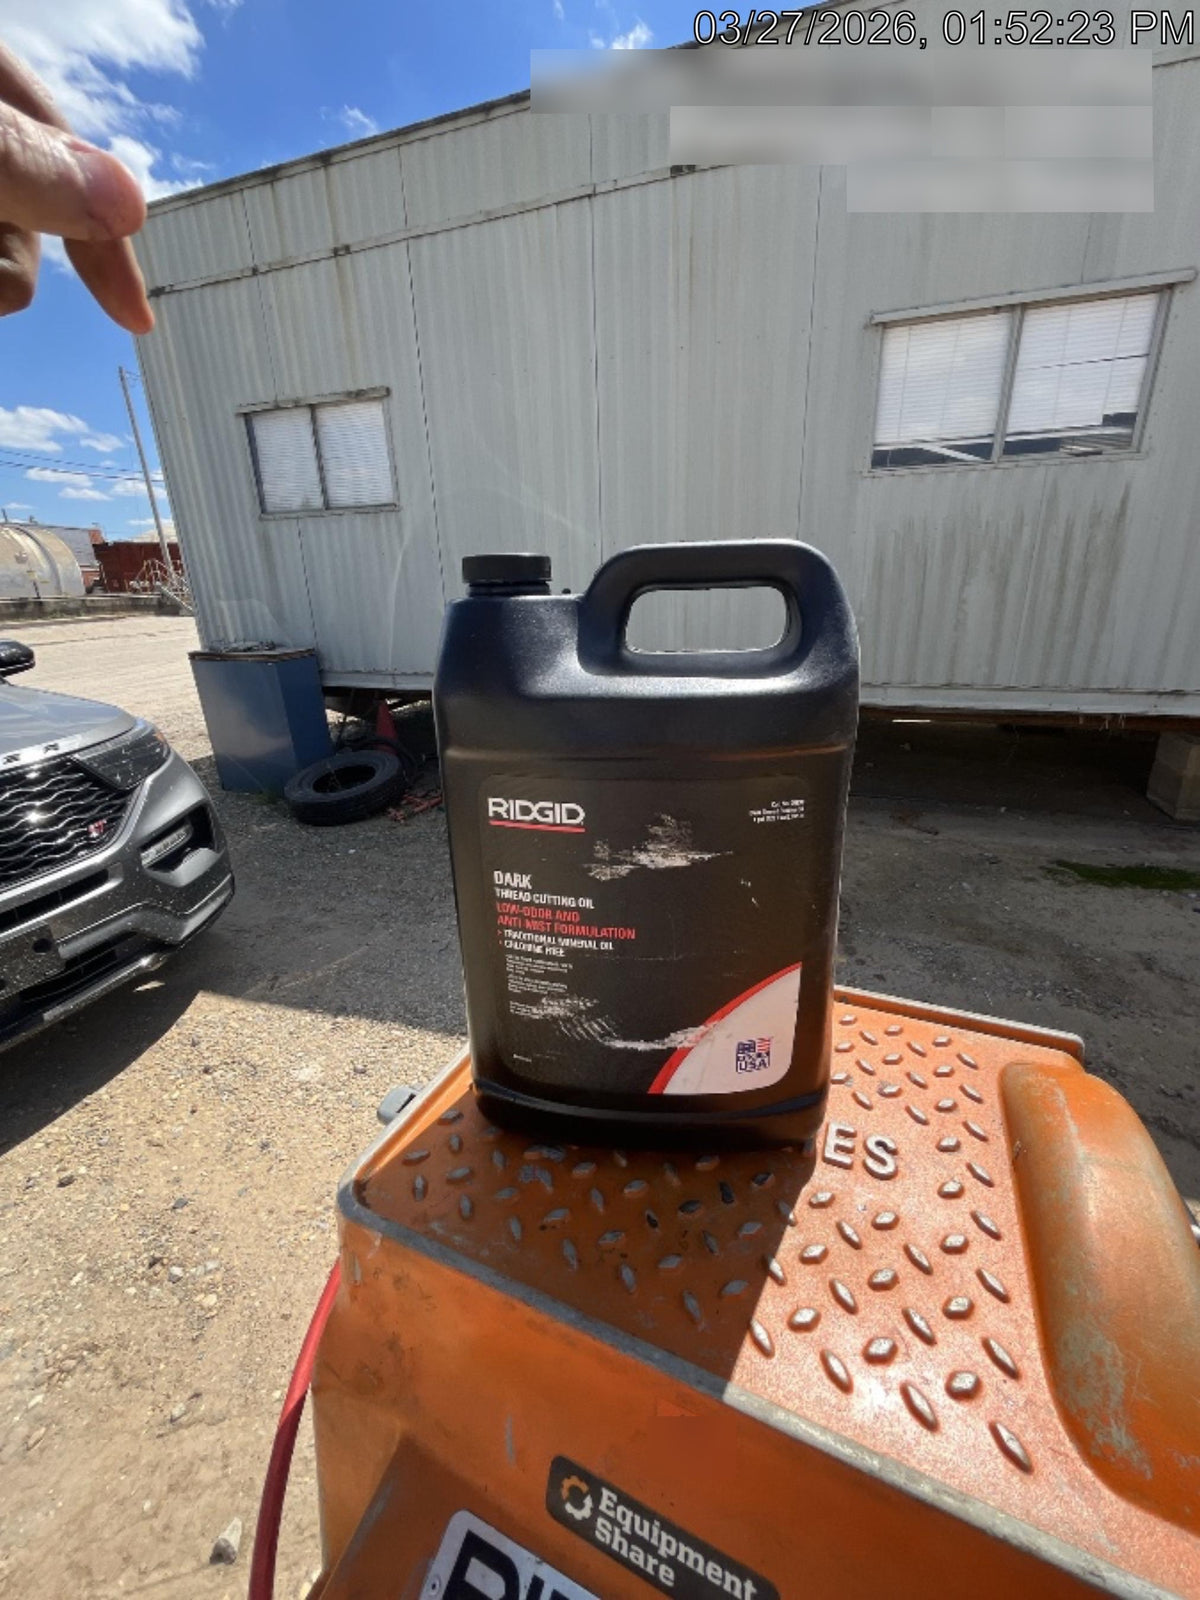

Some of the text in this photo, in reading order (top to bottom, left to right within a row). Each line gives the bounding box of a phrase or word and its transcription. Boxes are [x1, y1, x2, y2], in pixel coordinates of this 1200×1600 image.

[487, 797, 586, 825] RIDGID
[493, 870, 533, 889] DARK
[494, 887, 595, 909] THREAD CUTTING OIL
[496, 901, 580, 923] LOW-ODOR AND
[554, 922, 636, 940] FORMULATION
[600, 940, 615, 951] OIL
[594, 1516, 676, 1588] Share
[599, 1486, 758, 1600] Equipment
